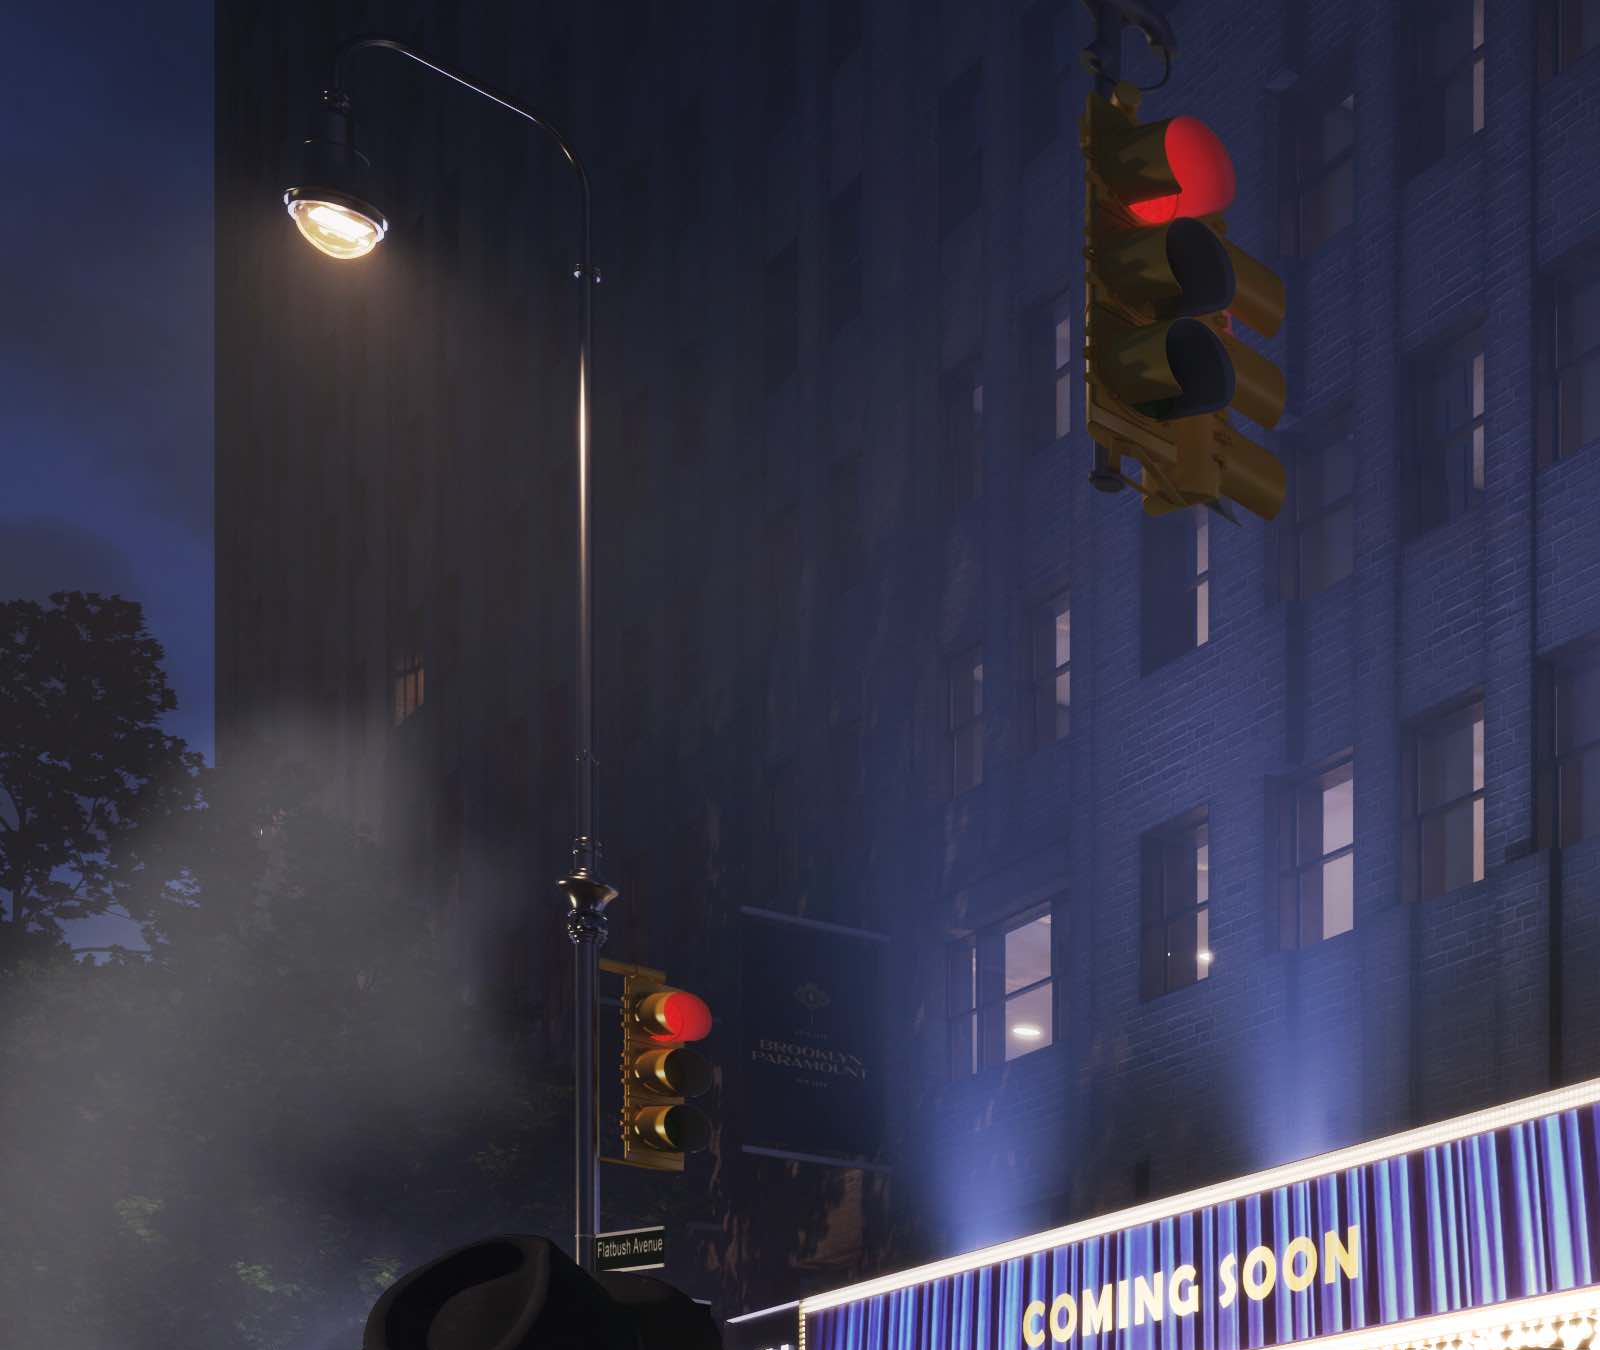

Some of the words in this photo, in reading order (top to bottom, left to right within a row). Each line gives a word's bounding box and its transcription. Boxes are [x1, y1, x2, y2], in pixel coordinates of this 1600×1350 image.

[751, 1050, 872, 1080] PARAMOUNT
[760, 1039, 864, 1066] BROOKLYN
[597, 1239, 631, 1259] Flatbush
[632, 1237, 663, 1253] Avenue
[1022, 1265, 1199, 1348] COMING
[1218, 1225, 1360, 1309] SOON
